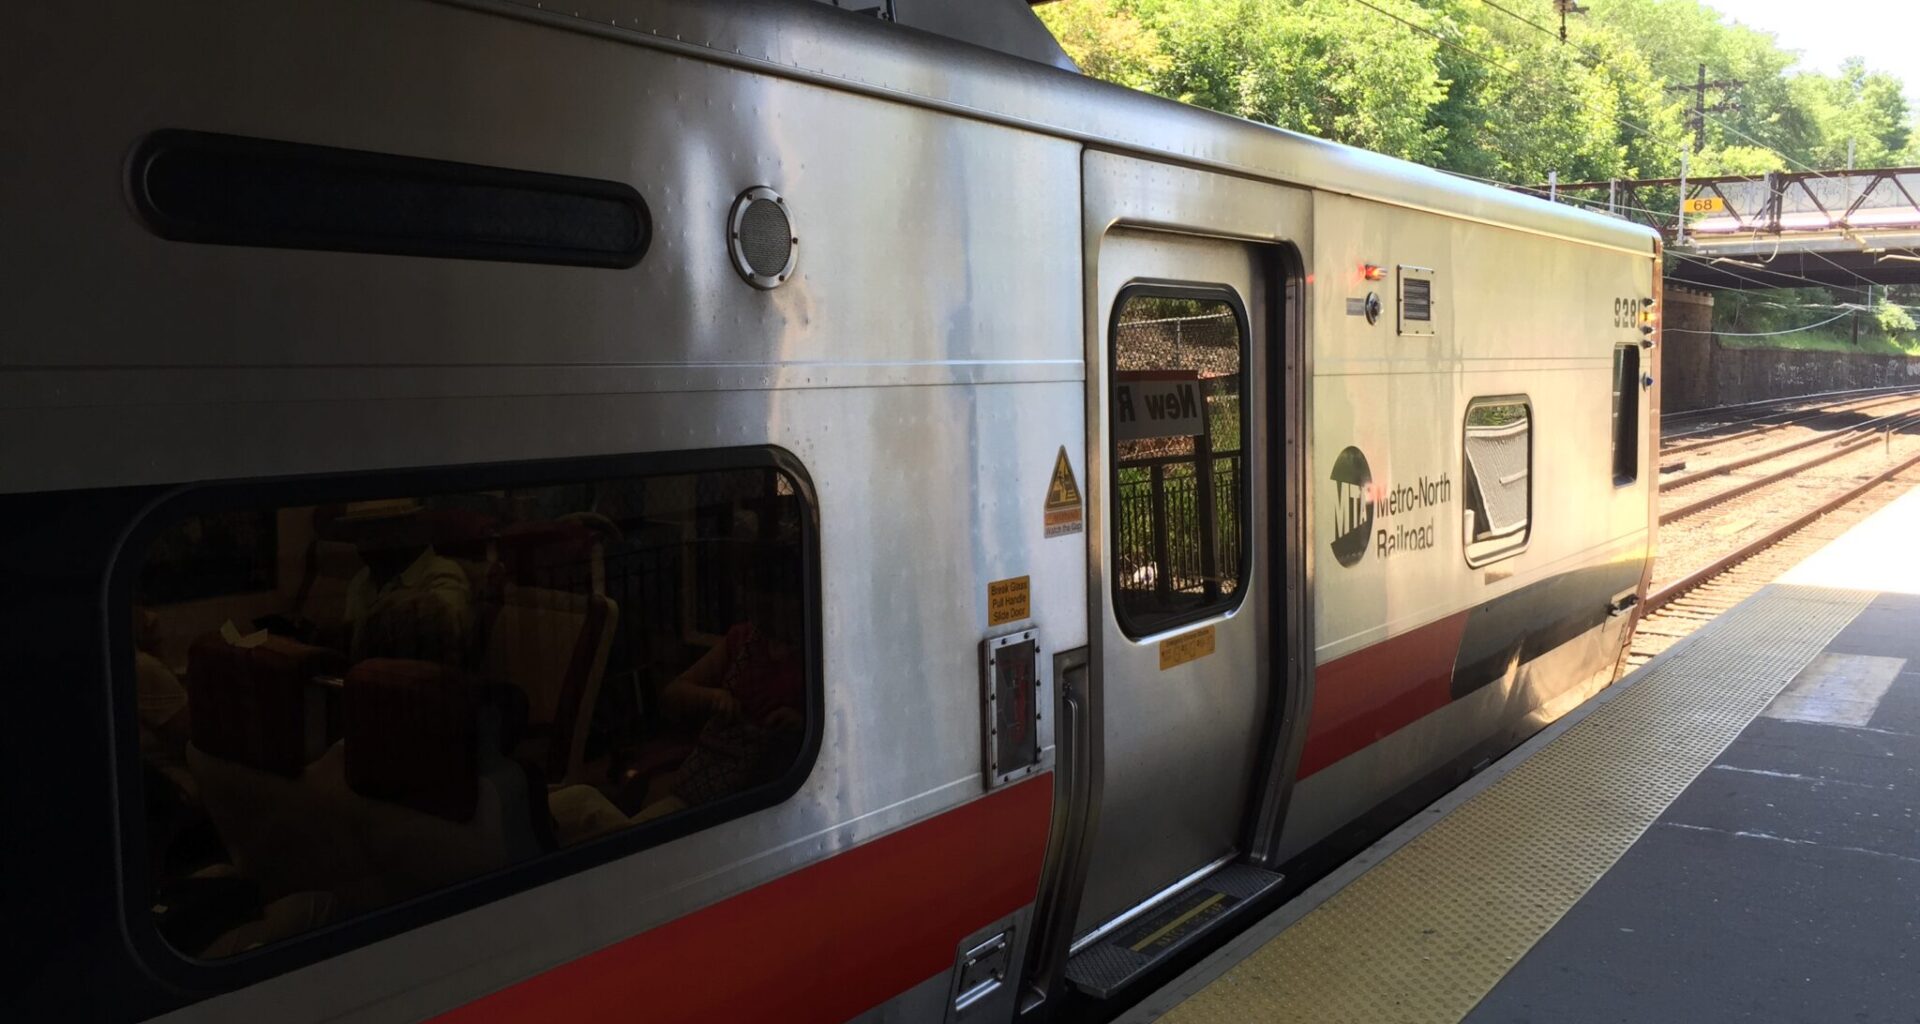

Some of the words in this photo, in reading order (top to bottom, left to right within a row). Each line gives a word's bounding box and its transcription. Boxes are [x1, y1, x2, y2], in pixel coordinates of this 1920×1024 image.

[1694, 199, 1713, 211] 68
[1334, 479, 1370, 539] MTA
[1376, 472, 1451, 519] Metro-North
[1377, 517, 1434, 559] Railroad
